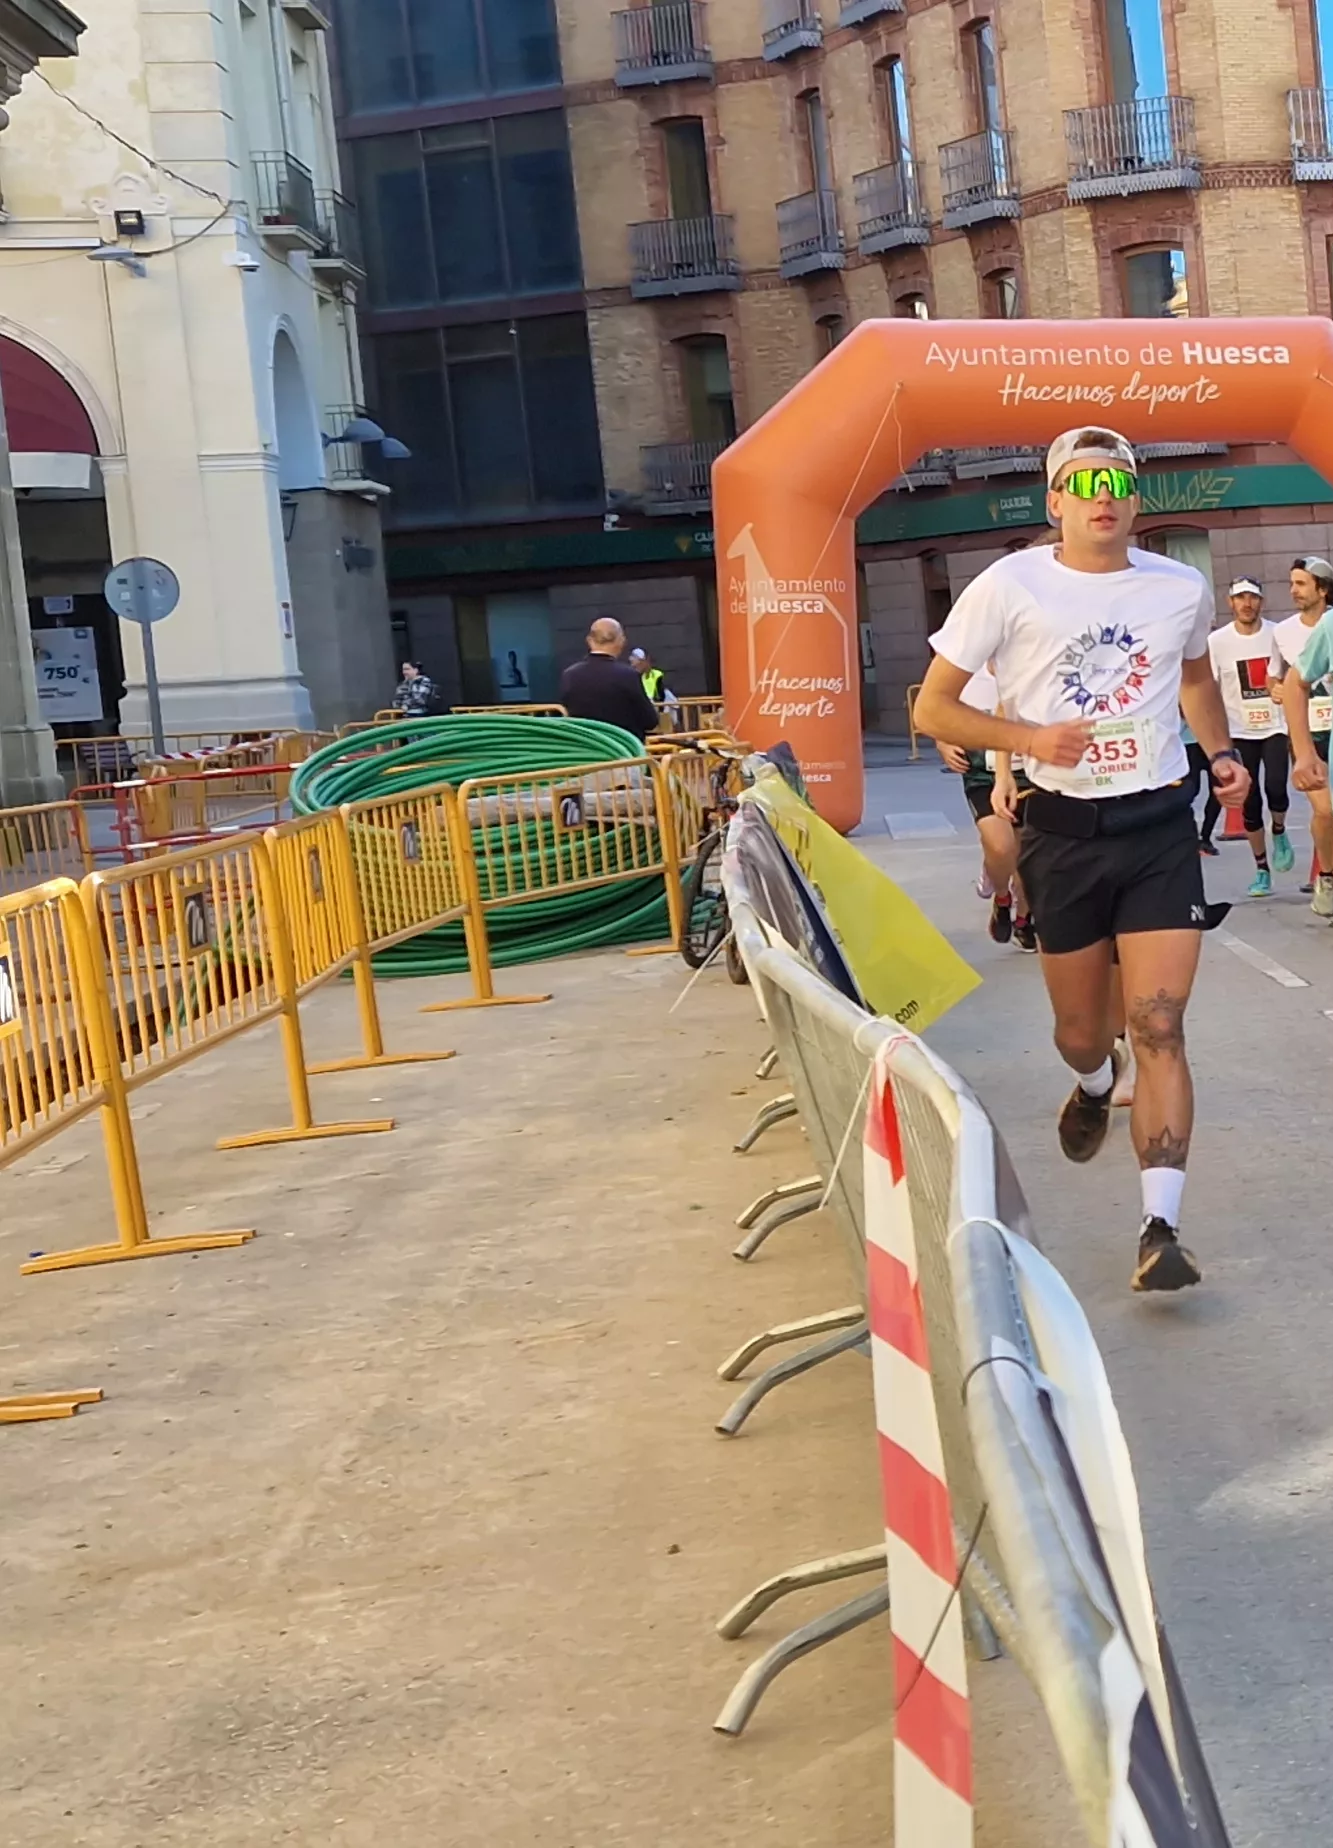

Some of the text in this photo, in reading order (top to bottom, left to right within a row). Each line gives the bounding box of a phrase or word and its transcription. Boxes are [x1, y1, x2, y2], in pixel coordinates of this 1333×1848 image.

[925, 341, 1290, 371] Ayuntamiento de Huesca
[999, 370, 1221, 415] Hacemos deporte
[728, 576, 847, 598] Ayuntamiento
[730, 599, 825, 615] de Huesca
[43, 666, 79, 681] 750
[757, 668, 845, 694] Hacemos
[758, 692, 836, 728] deporte
[1316, 707, 1332, 719] 57
[1086, 737, 1139, 765] 353
[802, 772, 832, 783] esca
[1090, 762, 1138, 776] LORIEN
